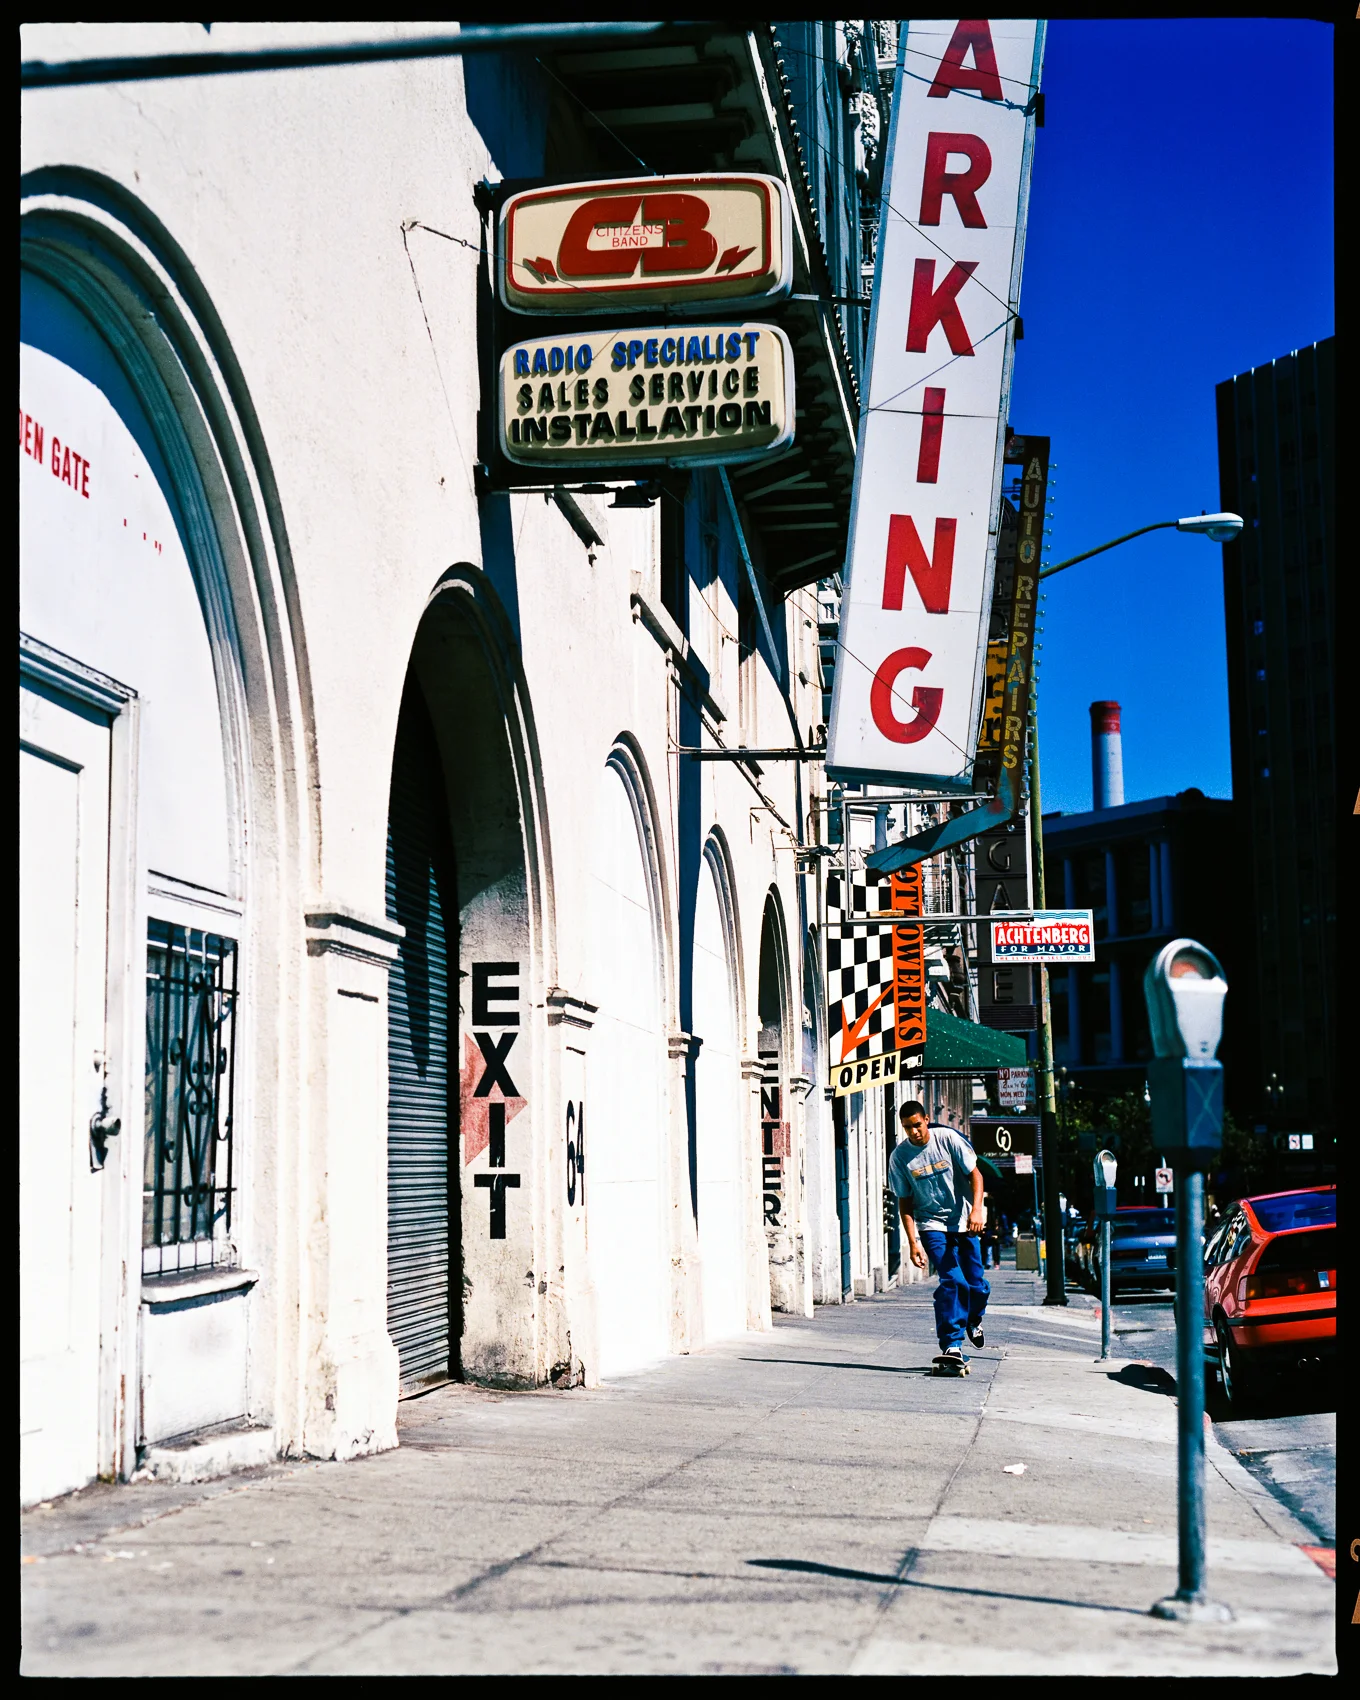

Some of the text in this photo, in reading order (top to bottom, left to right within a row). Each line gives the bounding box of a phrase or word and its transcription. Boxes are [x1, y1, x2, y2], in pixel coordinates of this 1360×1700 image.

[556, 193, 719, 278] CB
[596, 224, 664, 238] CITIZENS
[612, 235, 649, 248] BAND
[515, 331, 761, 376] RADIO SPECIALIST
[519, 366, 760, 411] SALES SERVICE
[511, 400, 772, 444] INSTALLATION
[51, 436, 90, 499] GATE
[1002, 457, 1043, 769] AUTO REPAIRS
[997, 926, 1089, 944] ACHTENBERG
[1001, 944, 1086, 953] FOR MAYOR
[839, 1054, 897, 1089] OPEN
[472, 961, 521, 1240] EXIT
[566, 1099, 586, 1208] 64
[758, 1050, 782, 1227] ENTER
